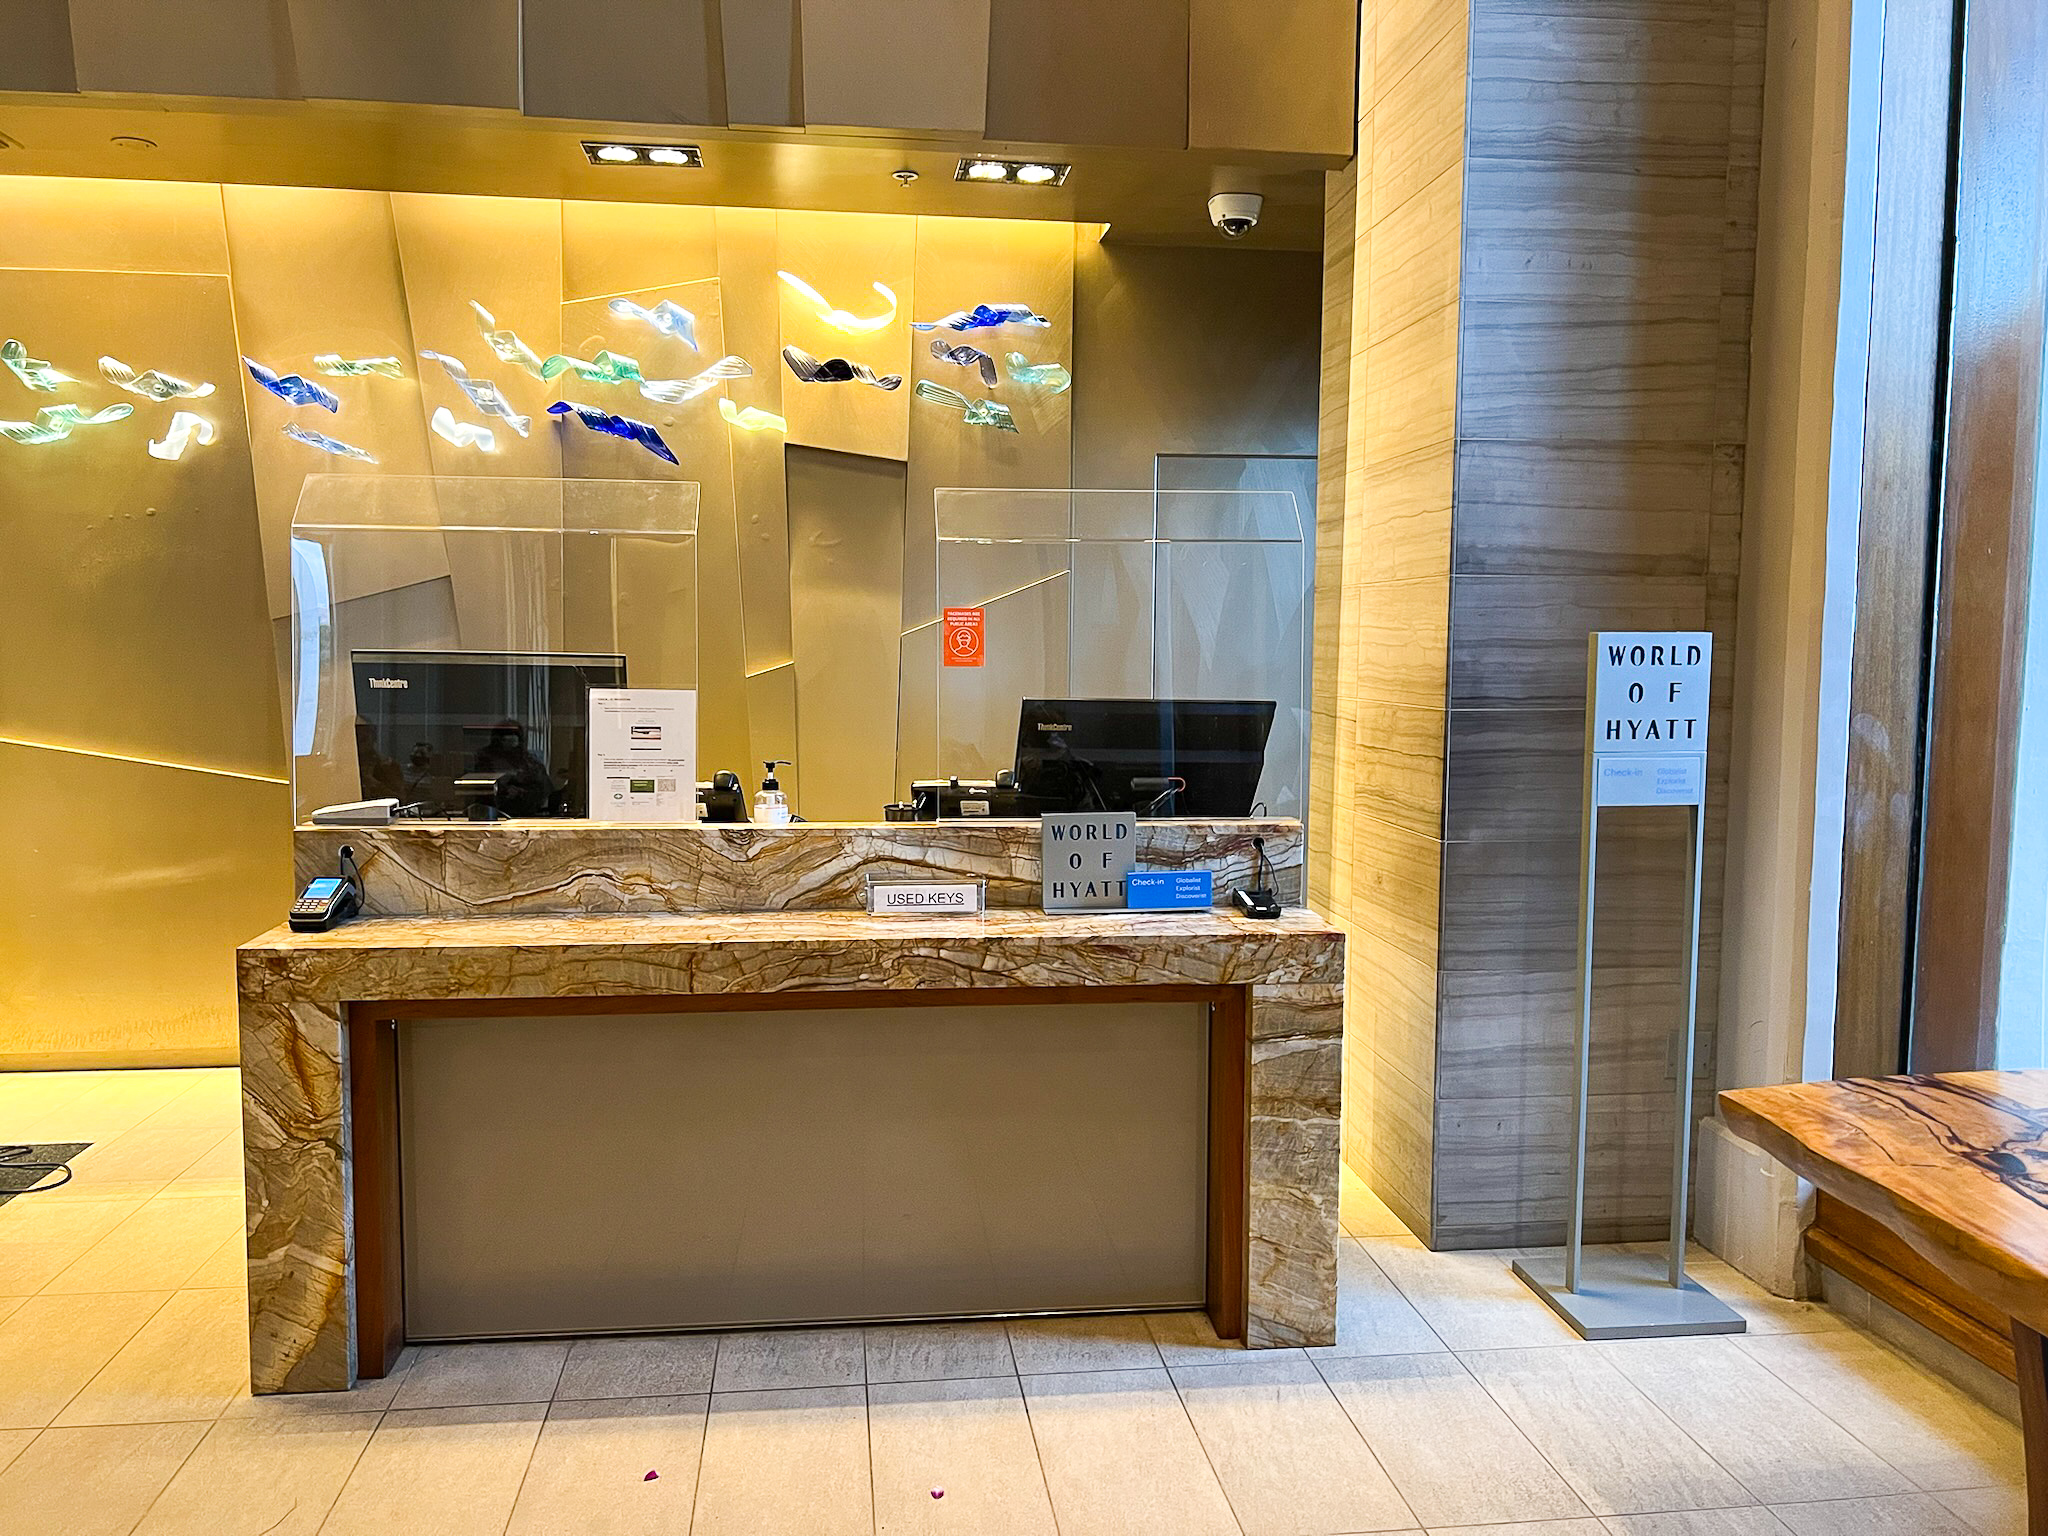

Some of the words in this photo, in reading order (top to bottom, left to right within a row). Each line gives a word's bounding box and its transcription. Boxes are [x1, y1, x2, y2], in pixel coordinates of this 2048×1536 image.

[1608, 645, 1701, 667] WORLD
[1628, 682, 1682, 703] OF
[1606, 719, 1697, 740] HYATT
[1603, 768, 1643, 777] Check-in
[1051, 823, 1128, 841] WORLD
[1069, 852, 1113, 870] OF
[1052, 880, 1127, 899] HYATT
[1131, 878, 1165, 887] Check-in
[887, 893, 924, 905] USED
[928, 892, 964, 904] KEYS
